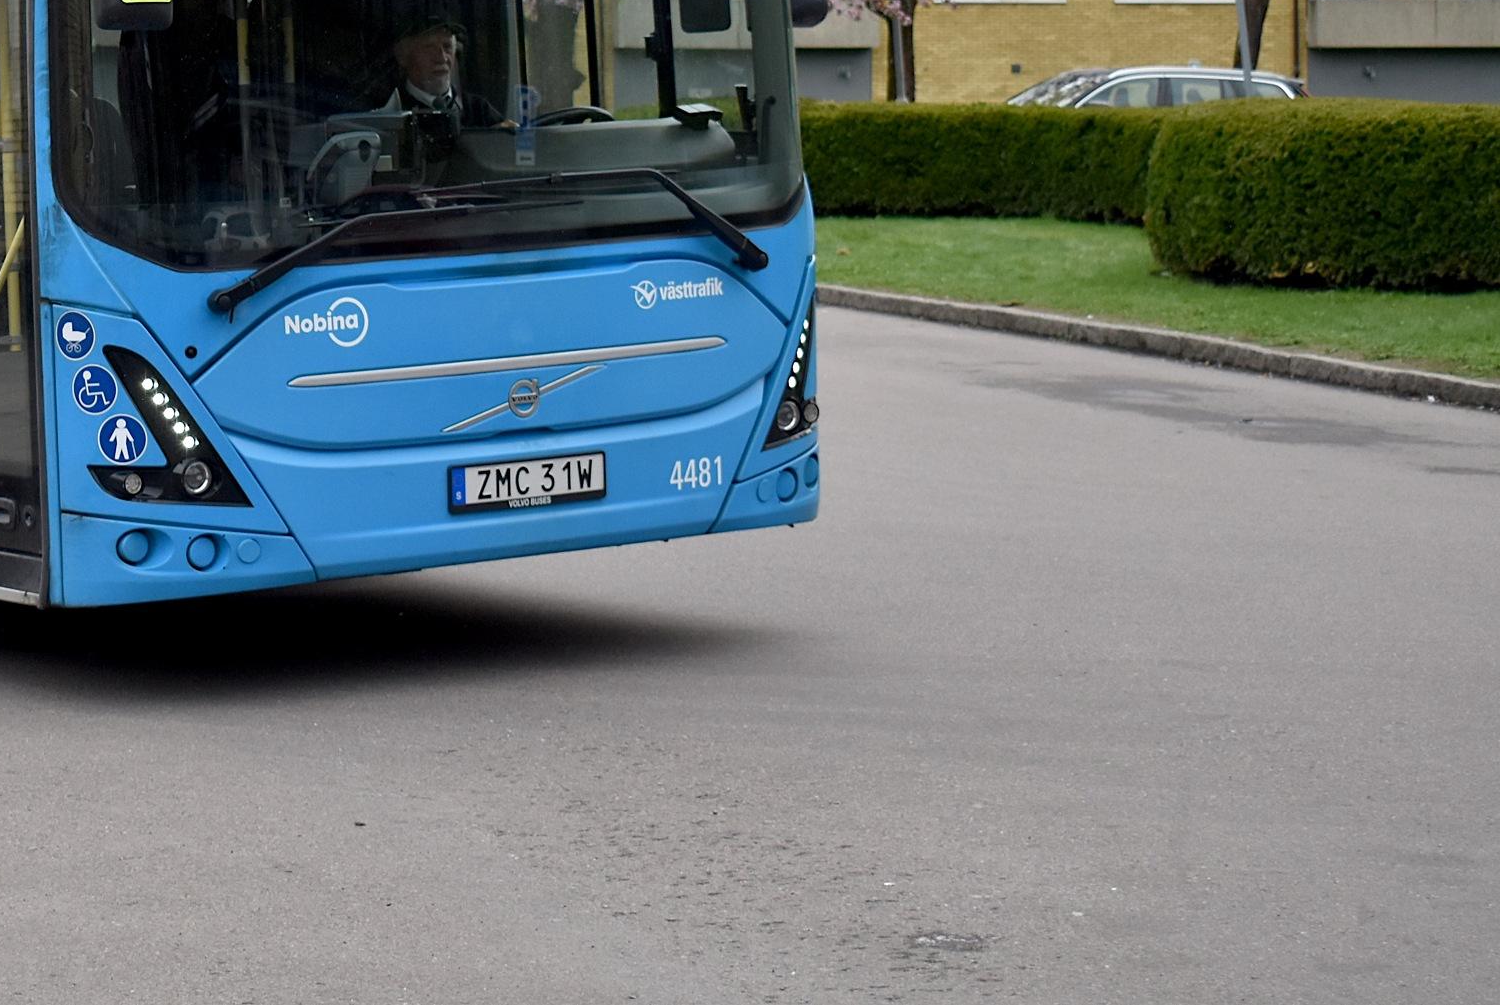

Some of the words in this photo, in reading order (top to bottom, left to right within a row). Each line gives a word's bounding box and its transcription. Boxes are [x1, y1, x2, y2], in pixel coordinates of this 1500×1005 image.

[659, 278, 724, 303] västtrafik
[284, 311, 360, 336] Nobina
[477, 466, 531, 500] ZMC
[540, 458, 594, 494] 31W
[669, 455, 724, 491] 4481
[508, 497, 530, 509] VOLVO
[530, 495, 552, 507] BUSES
